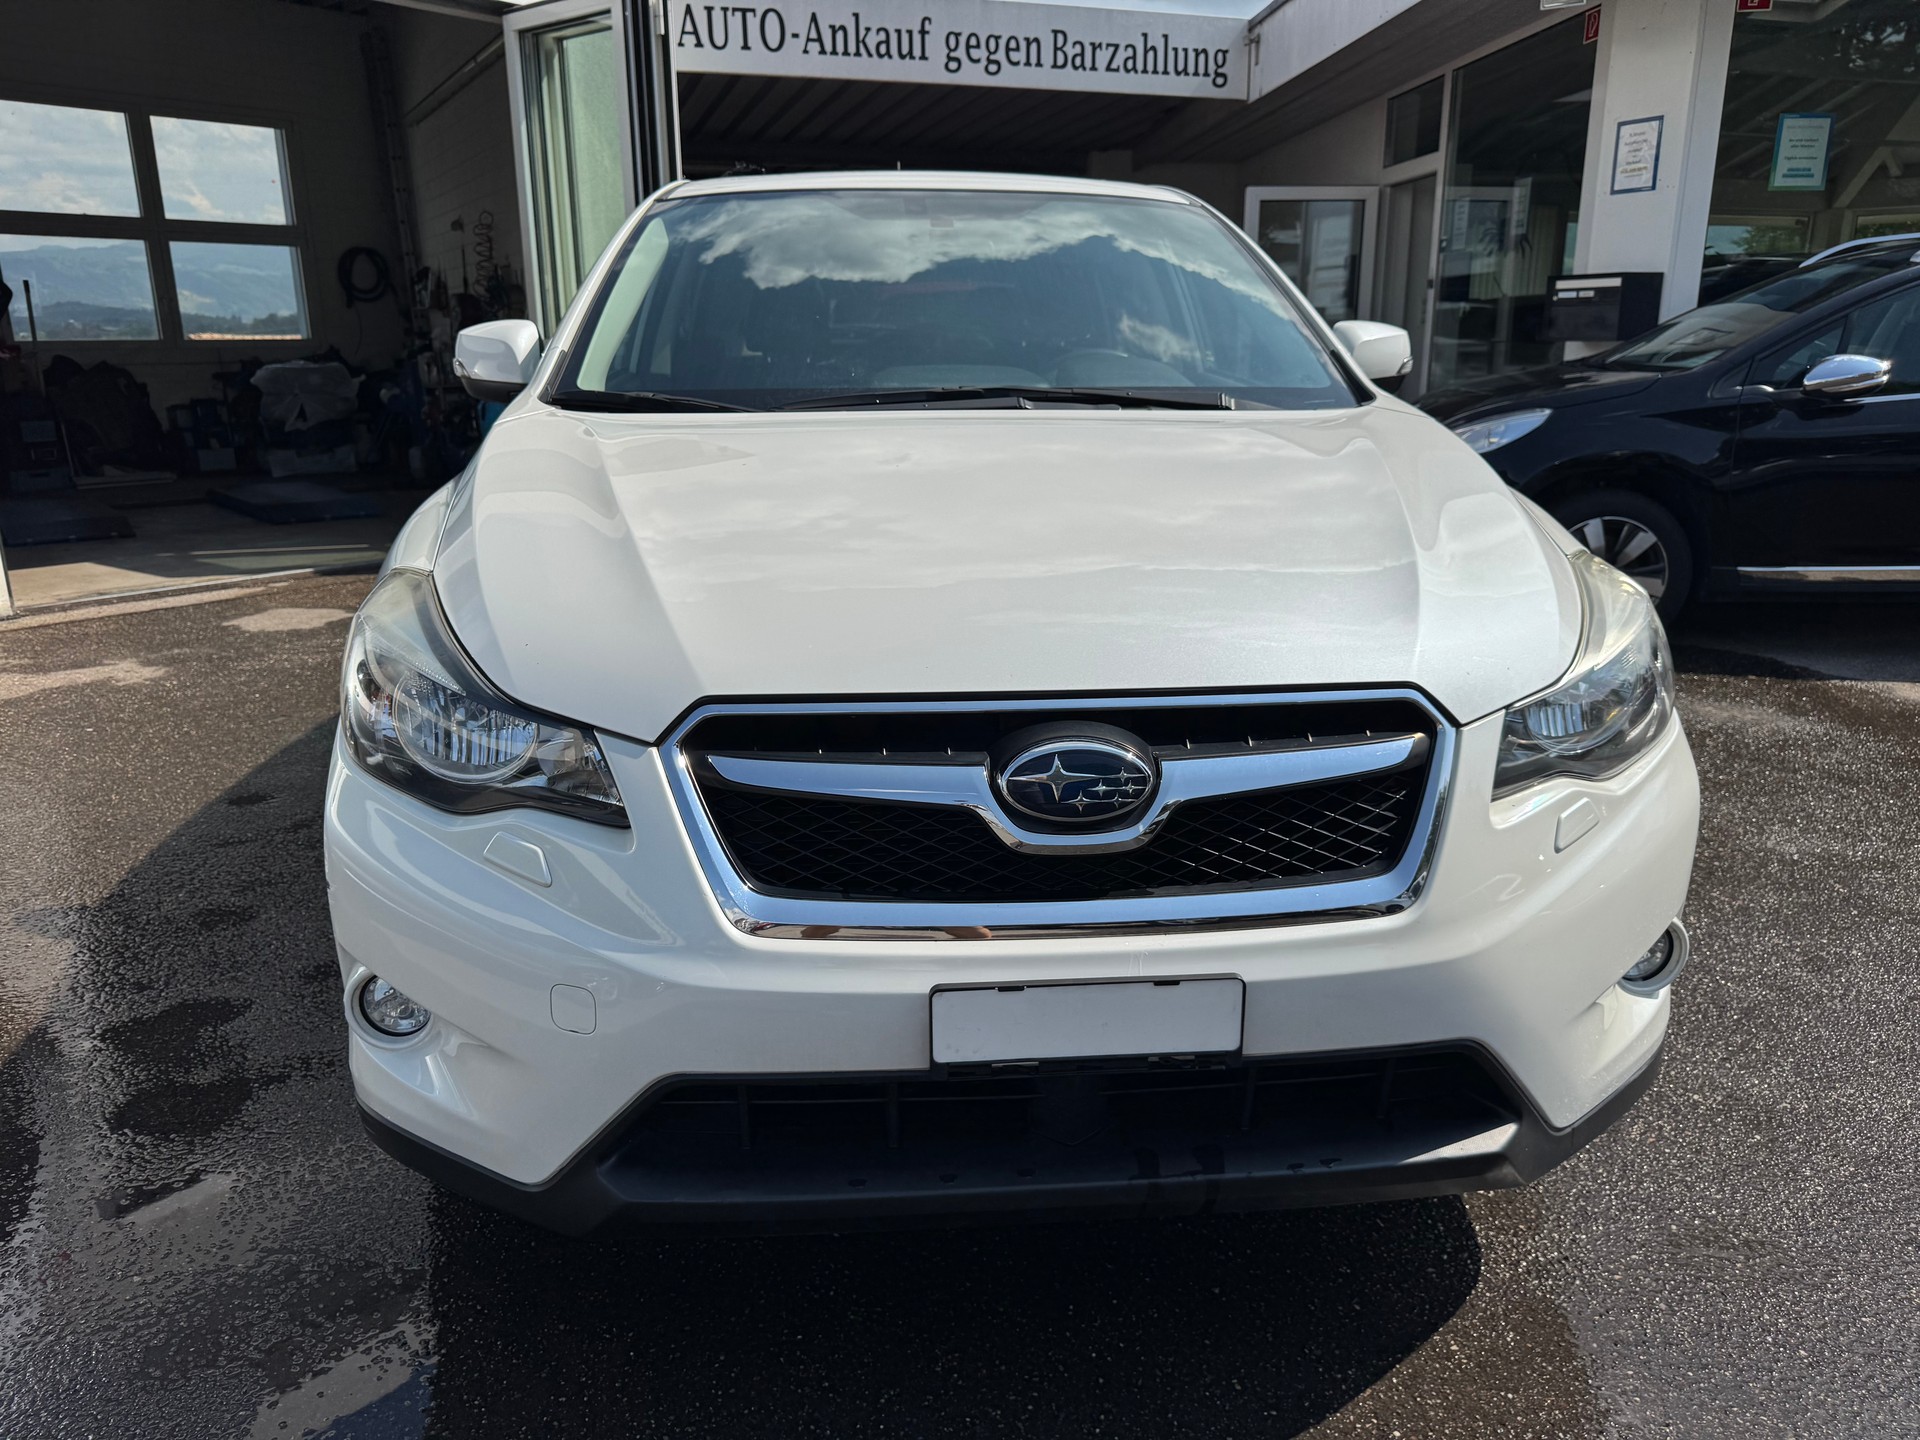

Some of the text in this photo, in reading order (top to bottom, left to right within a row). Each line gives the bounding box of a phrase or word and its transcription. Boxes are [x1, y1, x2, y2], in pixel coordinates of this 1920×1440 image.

[677, 3, 1230, 89] AUTO-Ankauf gegen Barzahlung
